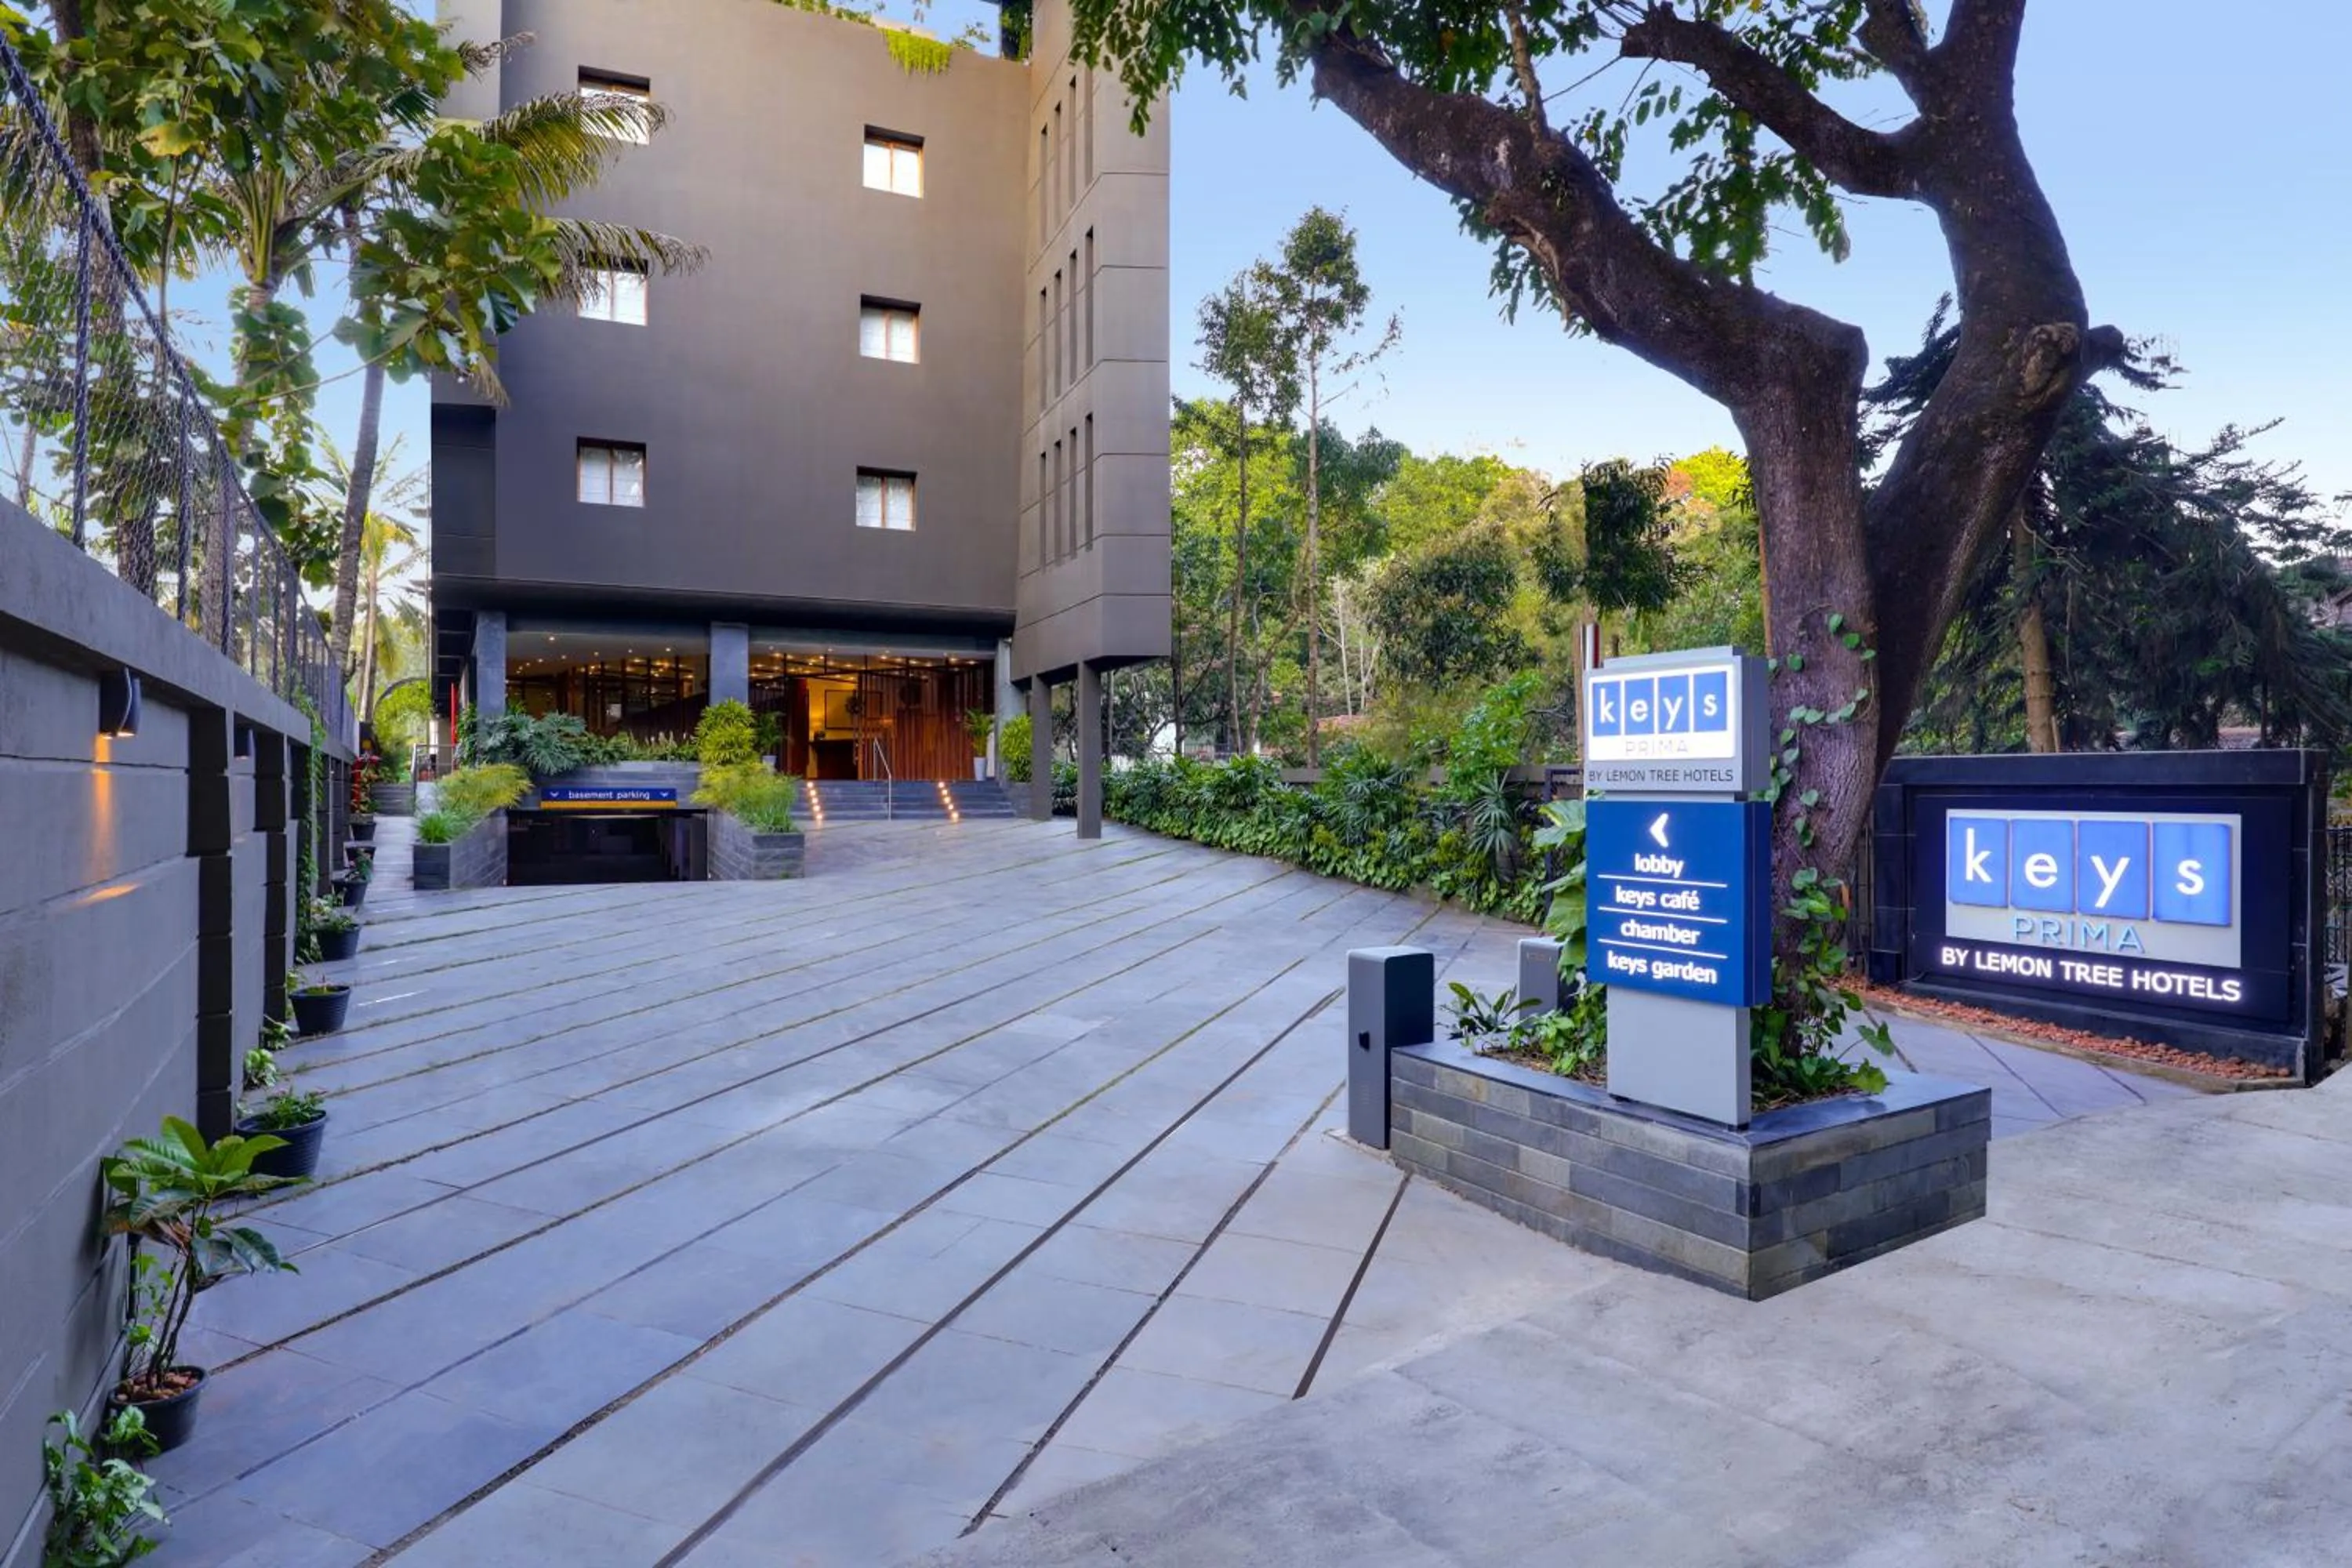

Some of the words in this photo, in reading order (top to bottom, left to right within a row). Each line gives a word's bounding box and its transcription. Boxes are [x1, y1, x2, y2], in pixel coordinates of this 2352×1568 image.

[1599, 687, 1719, 730] keys
[1624, 739, 1689, 756] PRIMA
[1588, 771, 1602, 782] BY
[1606, 770, 1646, 782] LEMON
[1649, 770, 1680, 782] TREE
[1683, 769, 1734, 782] HOTELS
[568, 790, 613, 800] basement
[616, 790, 650, 800] parking
[1634, 853, 1684, 879] lobby
[1964, 827, 2205, 908] keys
[1615, 885, 1657, 908] keys
[1661, 890, 1700, 911] café
[1620, 919, 1701, 945] chamber
[2012, 916, 2145, 953] PRIMA
[1607, 950, 1648, 974] keys
[1651, 959, 1718, 985] garden
[1941, 946, 1969, 967] BY
[1974, 953, 2053, 978] LEMON
[2059, 960, 2123, 987] TREE
[2132, 969, 2241, 1003] HOTELS
